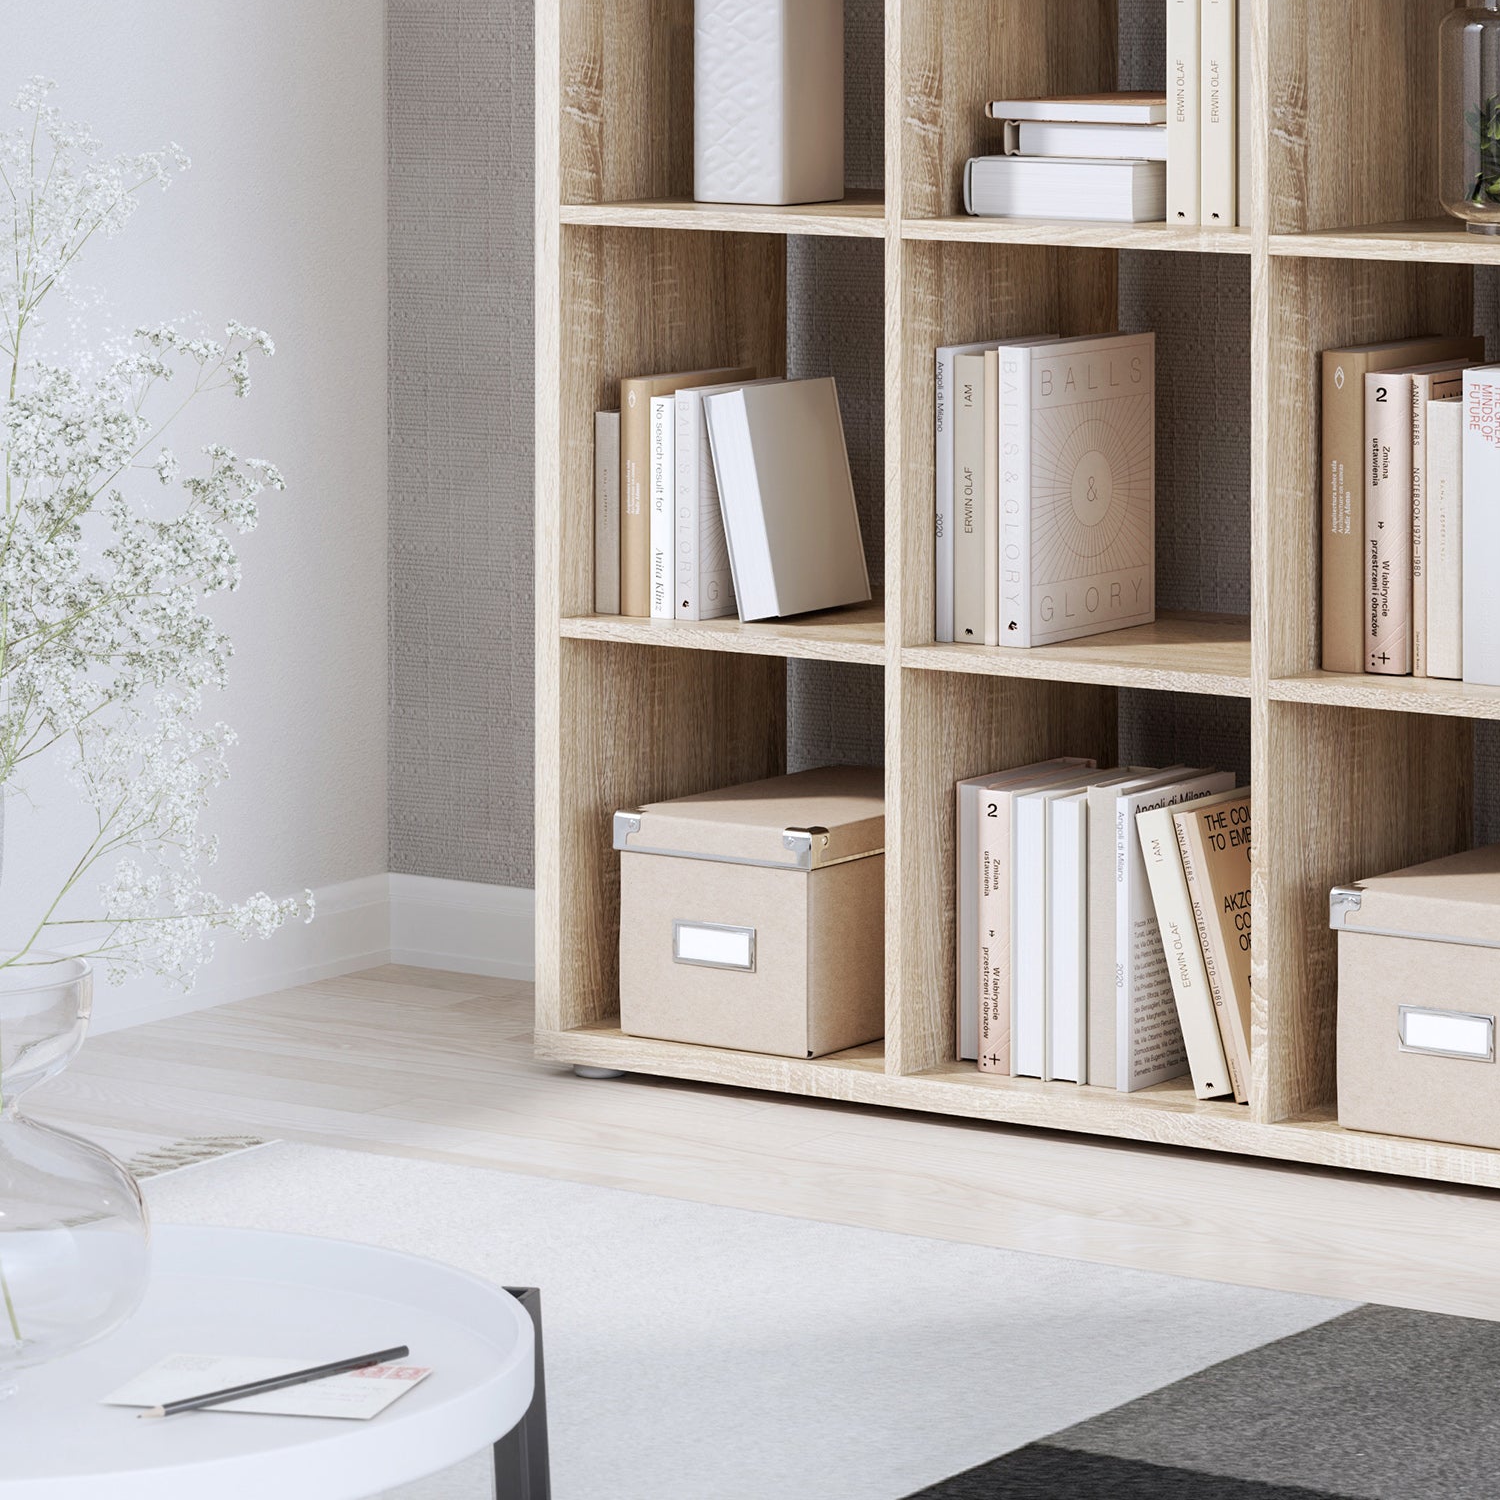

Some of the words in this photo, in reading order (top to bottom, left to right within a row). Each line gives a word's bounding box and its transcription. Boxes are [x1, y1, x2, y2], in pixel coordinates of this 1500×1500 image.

[1177, 59, 1185, 85] OLAF
[1210, 60, 1219, 86] OLAF
[1177, 86, 1185, 122] ERWIN
[1210, 87, 1219, 123] ERWIN
[1041, 357, 1142, 397] BALLS
[965, 384, 972, 402] AM
[1376, 387, 1387, 402] 2
[1469, 383, 1481, 430] FUTURE
[1482, 384, 1493, 423] MINDS
[656, 403, 664, 420] No
[655, 422, 664, 460] search
[1482, 426, 1493, 442] OF
[1372, 438, 1380, 486] ustawienia
[1382, 446, 1390, 479] Zmiana
[655, 463, 664, 495] result
[964, 466, 973, 495] OLAF
[1086, 476, 1098, 502] &
[655, 497, 664, 513] for
[964, 496, 973, 534] ERWIN
[935, 513, 943, 538] 2020
[1004, 499, 1020, 606] GLORY
[1370, 540, 1379, 590] przestrzeni
[1382, 560, 1389, 570] W
[1040, 577, 1143, 622] GLORY
[1371, 597, 1379, 637] obrazów
[987, 803, 998, 818] 2
[1204, 811, 1228, 831] THE
[1151, 839, 1162, 857] AM
[1208, 833, 1226, 852] TO
[1168, 922, 1183, 950] OLAF
[1194, 901, 1211, 956] NOTEBOOK
[982, 947, 990, 995] przestrzeni
[993, 967, 1000, 976] W
[1115, 963, 1123, 988] 2020
[1176, 952, 1191, 988] ERWIN
